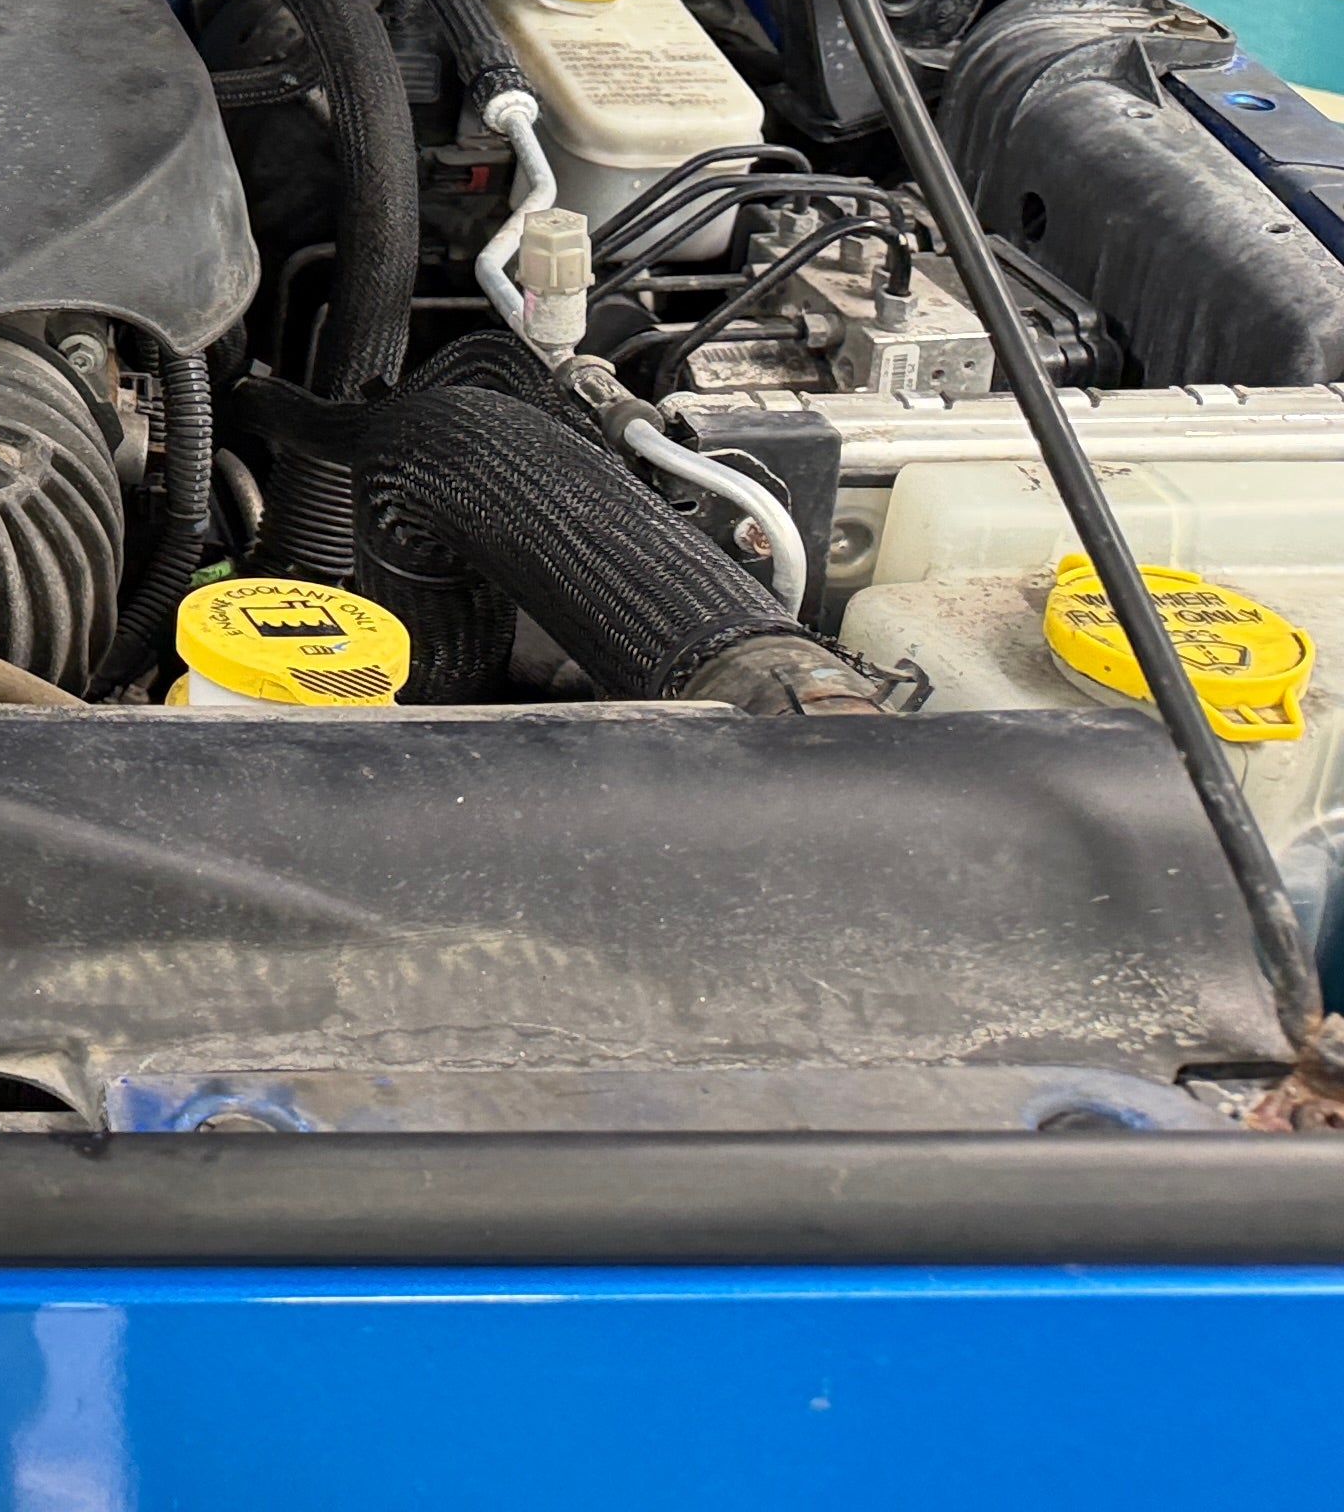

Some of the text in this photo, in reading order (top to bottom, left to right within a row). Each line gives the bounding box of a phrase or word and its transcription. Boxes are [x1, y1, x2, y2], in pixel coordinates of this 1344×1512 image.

[1072, 592, 1226, 608] WHER
[208, 586, 378, 637] ENGINE COOLANT ONLY
[1175, 608, 1264, 626] ONLY
